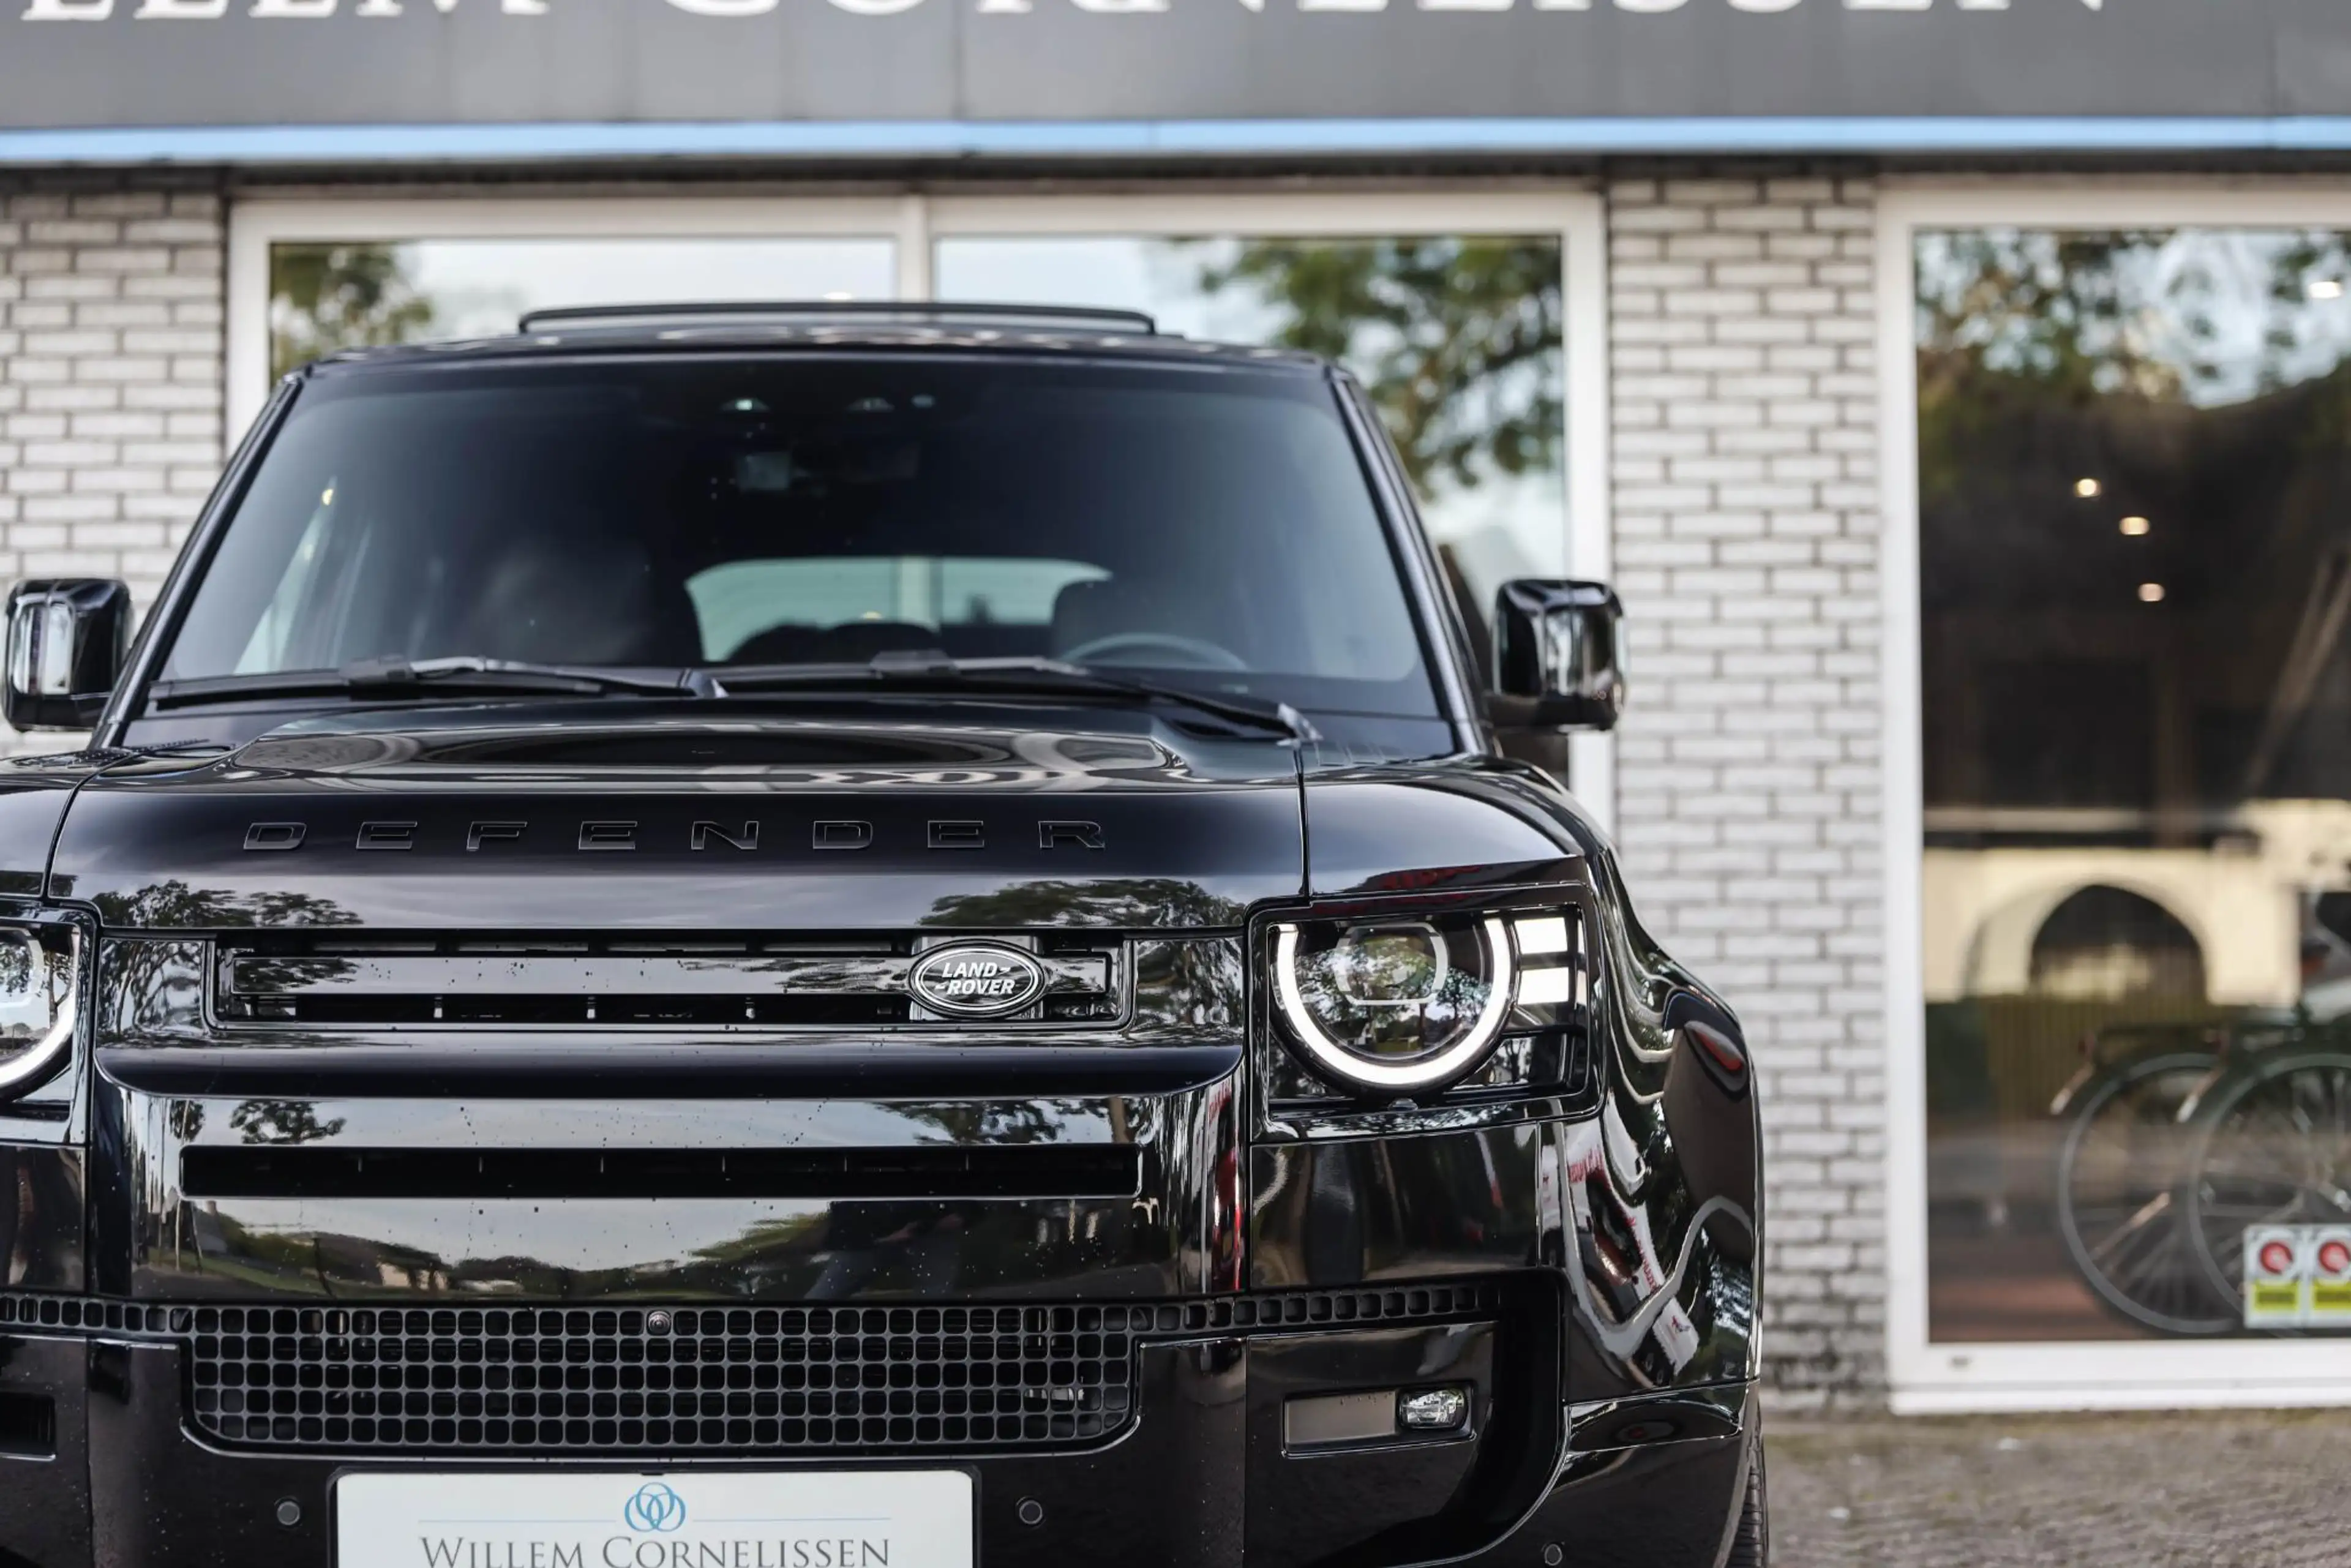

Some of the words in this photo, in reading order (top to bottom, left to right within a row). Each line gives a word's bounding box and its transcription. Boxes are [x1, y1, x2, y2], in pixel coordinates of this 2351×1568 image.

[244, 821, 1104, 850] DEFENDER
[942, 962, 998, 978] LAND
[947, 980, 1016, 995] ROVER
[419, 1536, 585, 1568] WILLEM
[602, 1536, 888, 1568] CORNELISSEN
